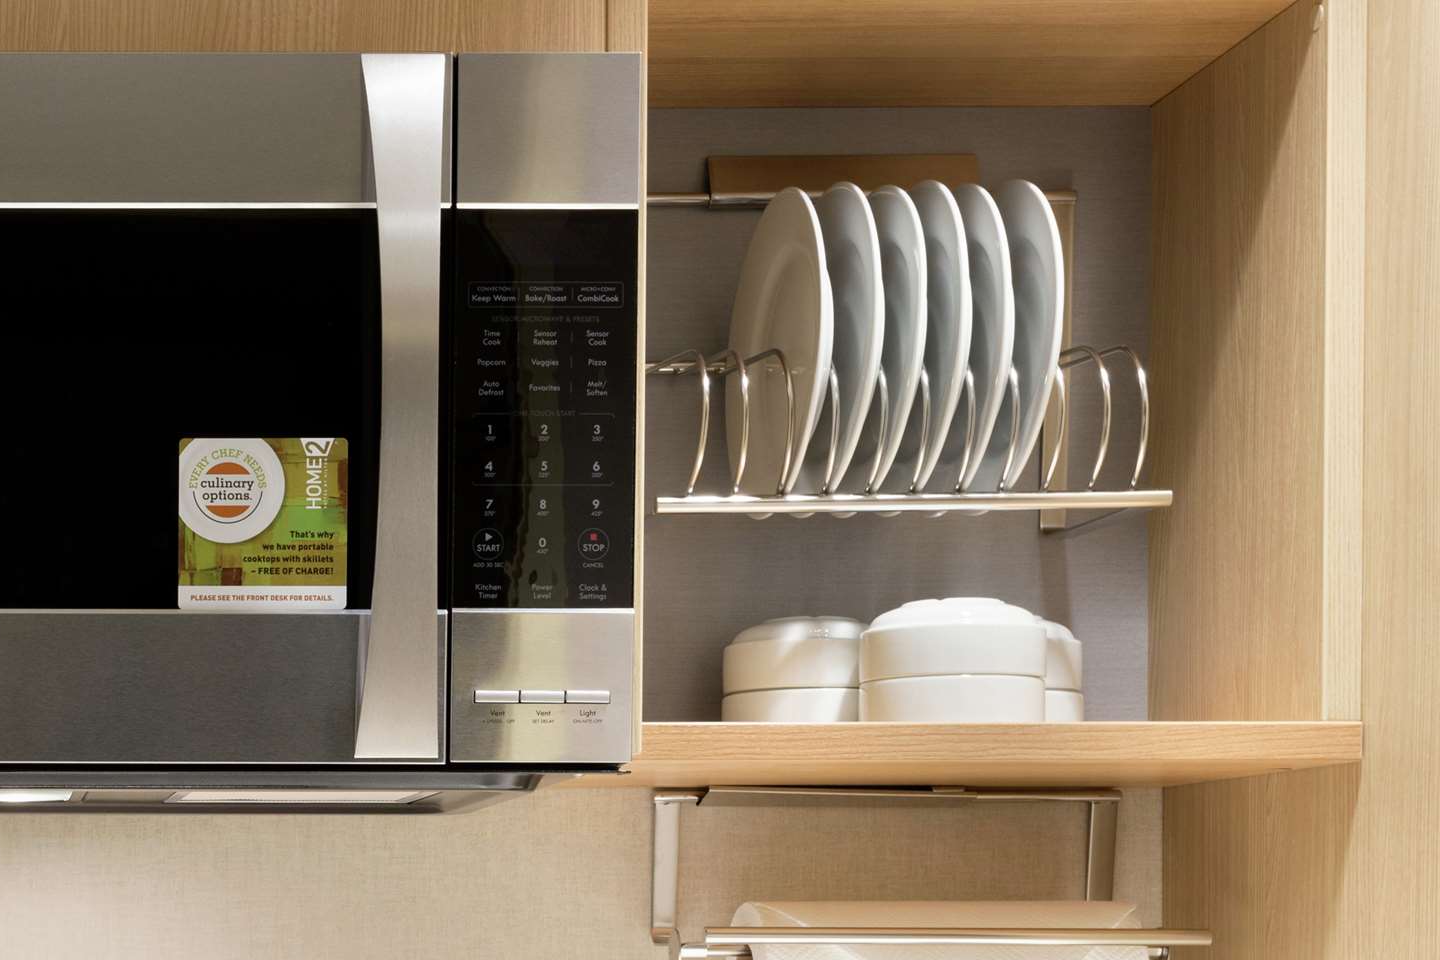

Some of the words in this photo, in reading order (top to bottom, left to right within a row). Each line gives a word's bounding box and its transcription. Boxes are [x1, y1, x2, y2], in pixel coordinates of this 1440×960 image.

[471, 294, 491, 303] Keep
[525, 294, 567, 303] Bake/Roast
[577, 294, 619, 302] CombiCook
[482, 338, 501, 346] Cook
[588, 338, 607, 346] Cook
[477, 359, 506, 367] Popcorn
[531, 359, 559, 367] Veggies
[487, 424, 492, 435] 1
[540, 424, 548, 435] 2
[593, 424, 601, 435] 3
[189, 456, 210, 489] EVERY
[211, 448, 243, 460] CHEF
[243, 454, 267, 489] NEEDS
[484, 461, 493, 472] 4
[540, 461, 548, 471] 5
[592, 461, 600, 472] 6
[200, 477, 254, 491] culinary
[202, 490, 252, 503] options.
[485, 499, 493, 509] 7
[539, 499, 547, 509] 8
[592, 499, 600, 509] 9
[316, 531, 334, 540] why
[538, 537, 547, 548] 0
[276, 543, 296, 551] have
[298, 543, 334, 552] portable
[476, 544, 500, 552] START
[582, 544, 605, 552] STOP
[243, 555, 280, 564] cooktops
[258, 567, 281, 575] FREE
[282, 567, 294, 575] OF
[295, 567, 334, 575] CHARGE!
[579, 592, 607, 601] Settings
[580, 710, 597, 718] Light
